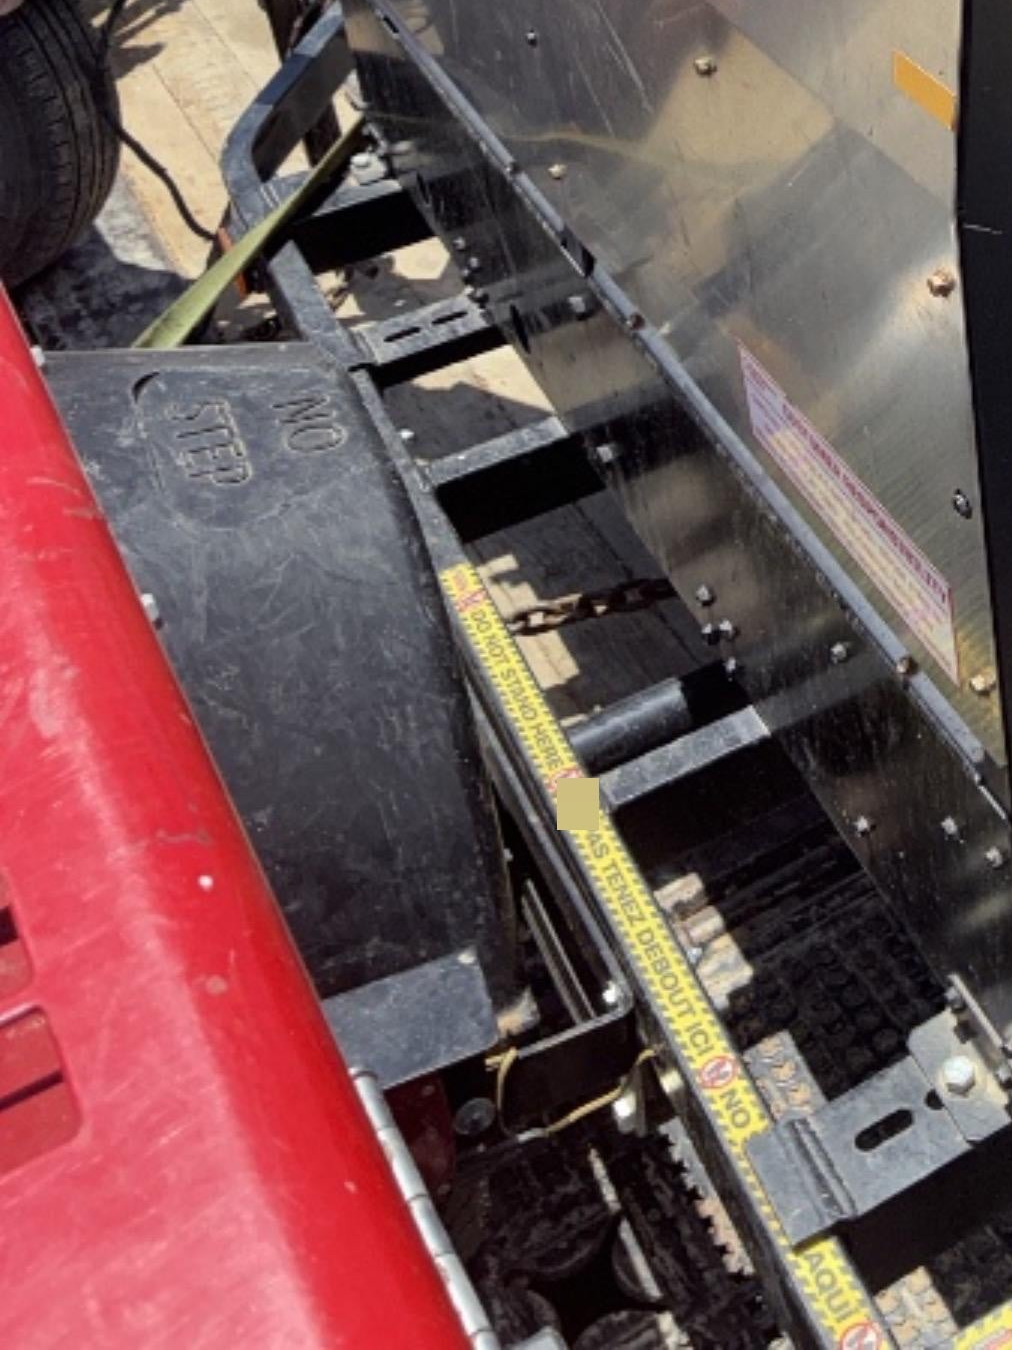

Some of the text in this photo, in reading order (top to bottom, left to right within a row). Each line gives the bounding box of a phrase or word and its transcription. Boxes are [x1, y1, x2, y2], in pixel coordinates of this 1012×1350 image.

[272, 394, 348, 452] NO
[470, 610, 564, 770] DO NOT STAND HERE
[588, 830, 715, 1057] AS TENEZ DEBOUT ICI
[720, 1087, 751, 1129] NO
